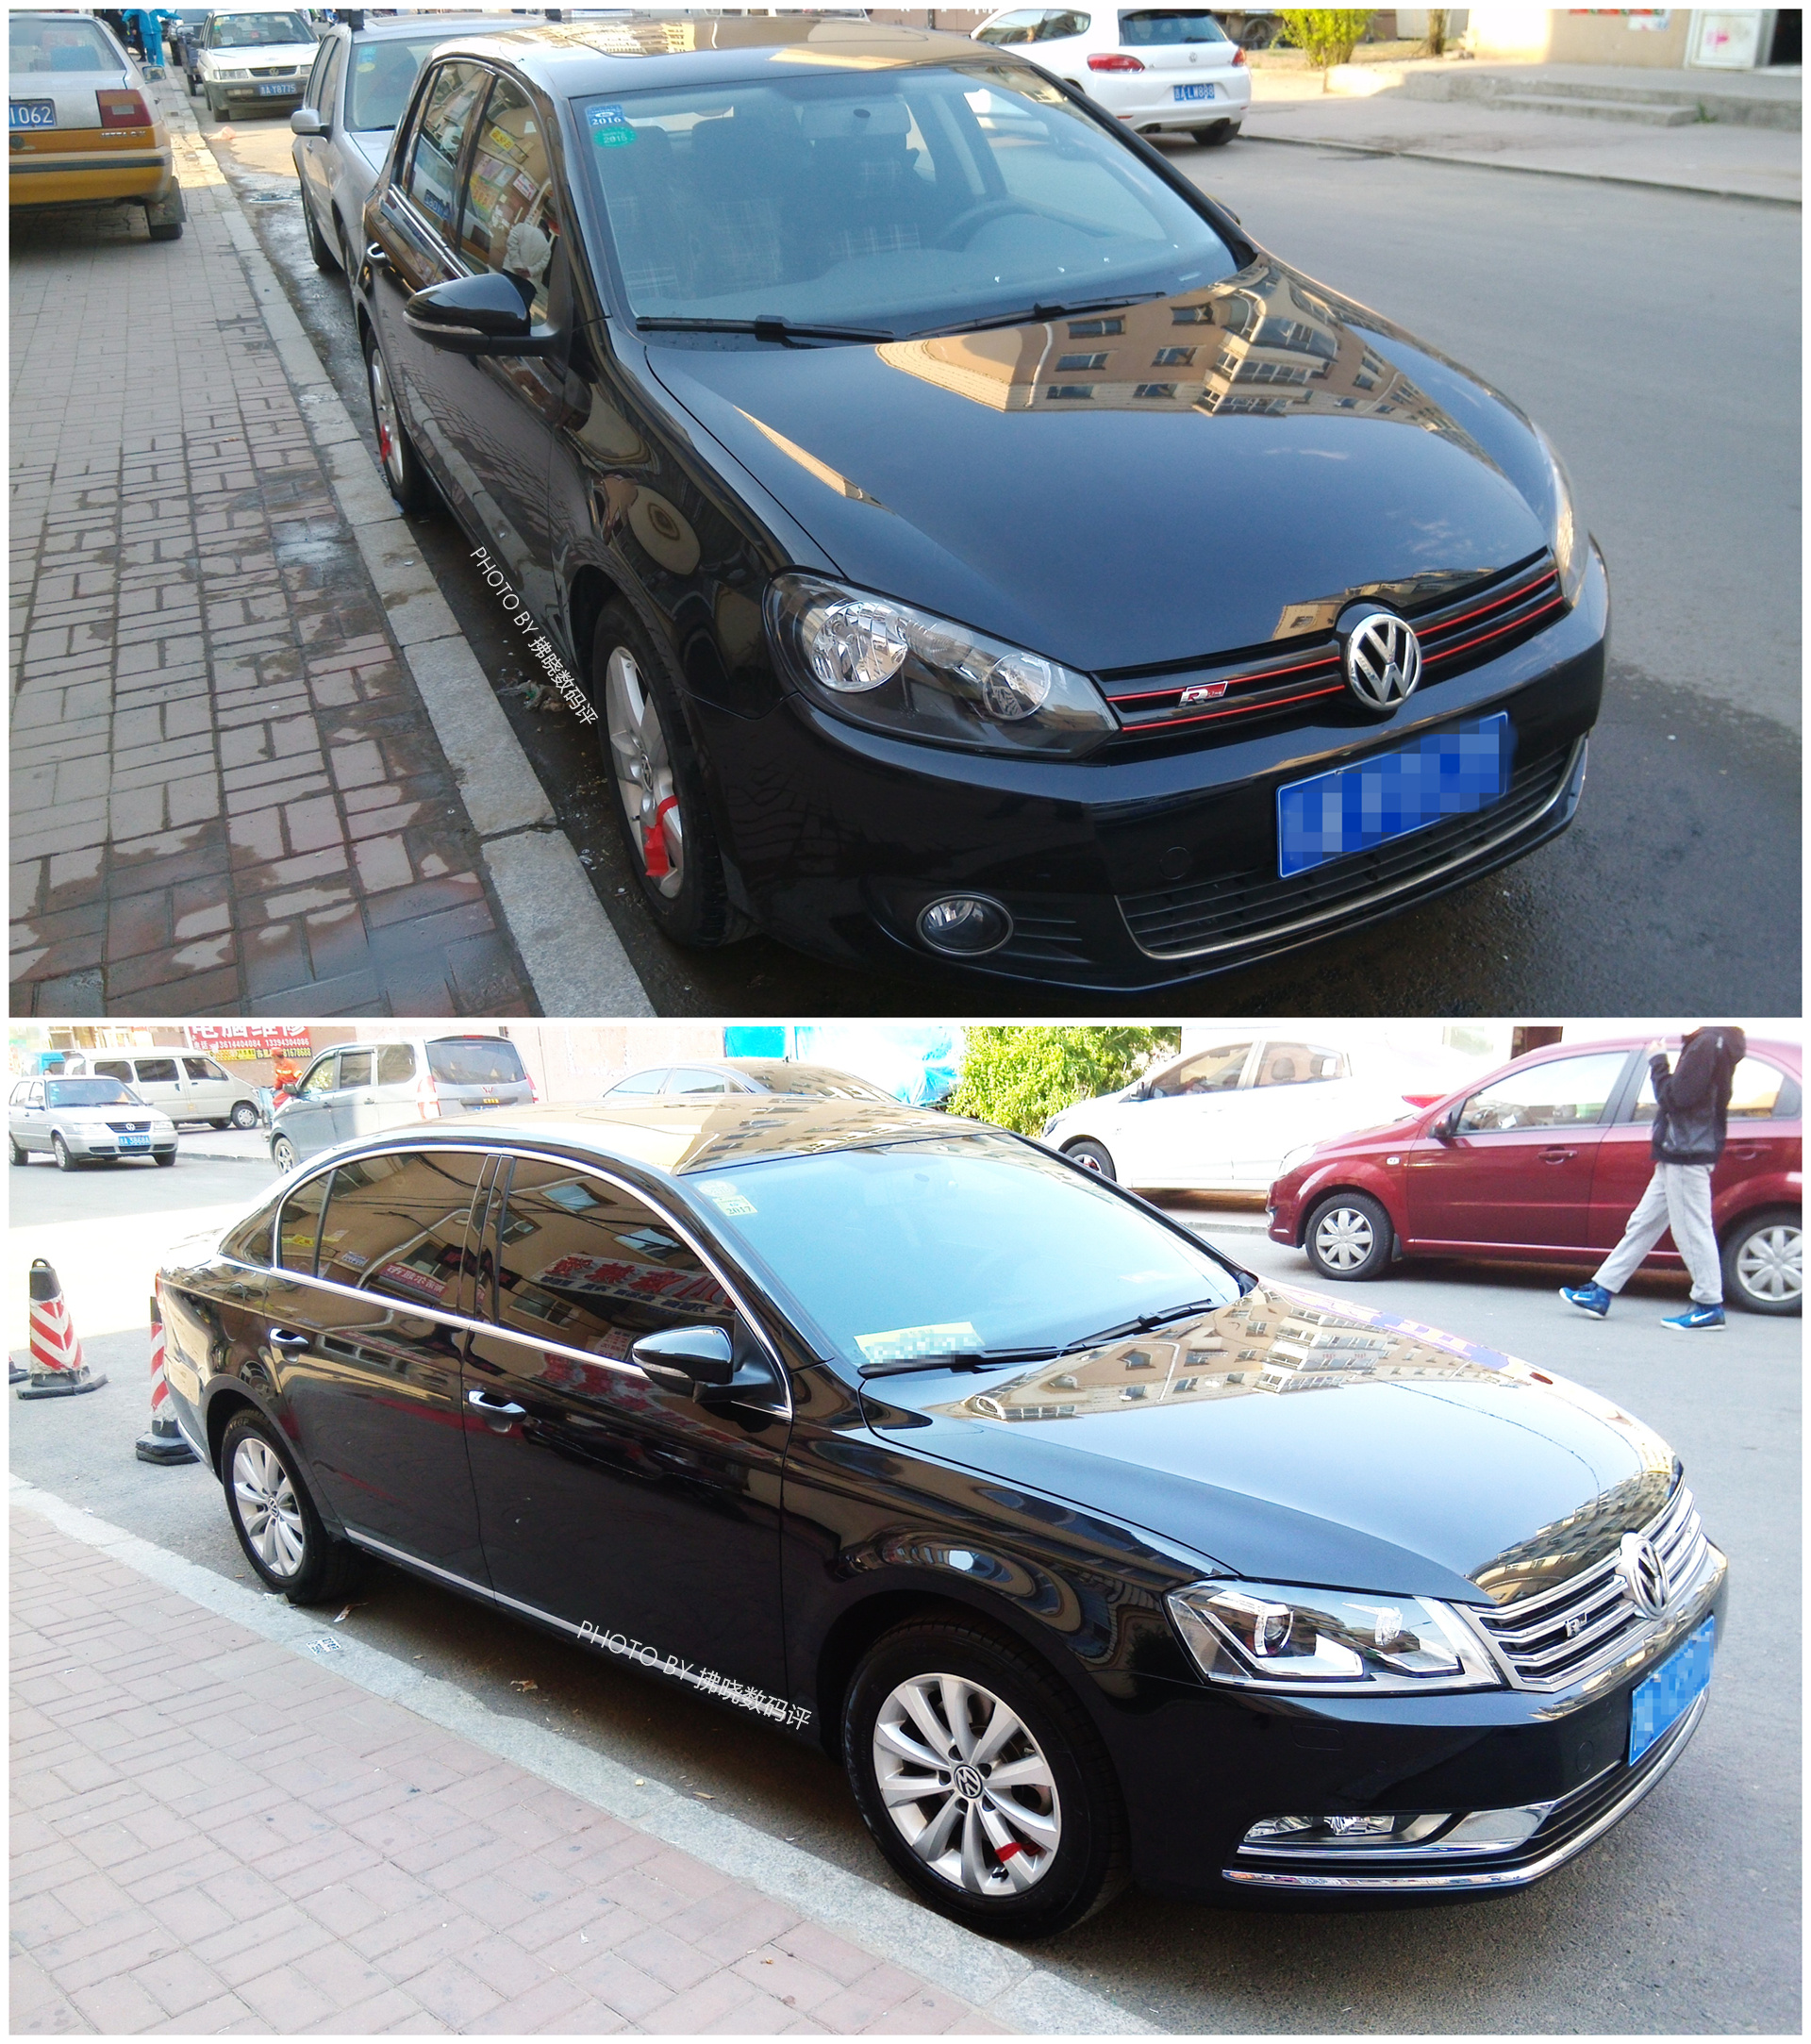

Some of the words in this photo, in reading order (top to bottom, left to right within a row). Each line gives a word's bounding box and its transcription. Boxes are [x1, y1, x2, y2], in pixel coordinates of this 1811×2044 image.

[10, 106, 53, 125] 1062
[591, 117, 622, 125] 2016
[192, 1026, 307, 1039] 电脑维修
[726, 1205, 752, 1215] 2017
